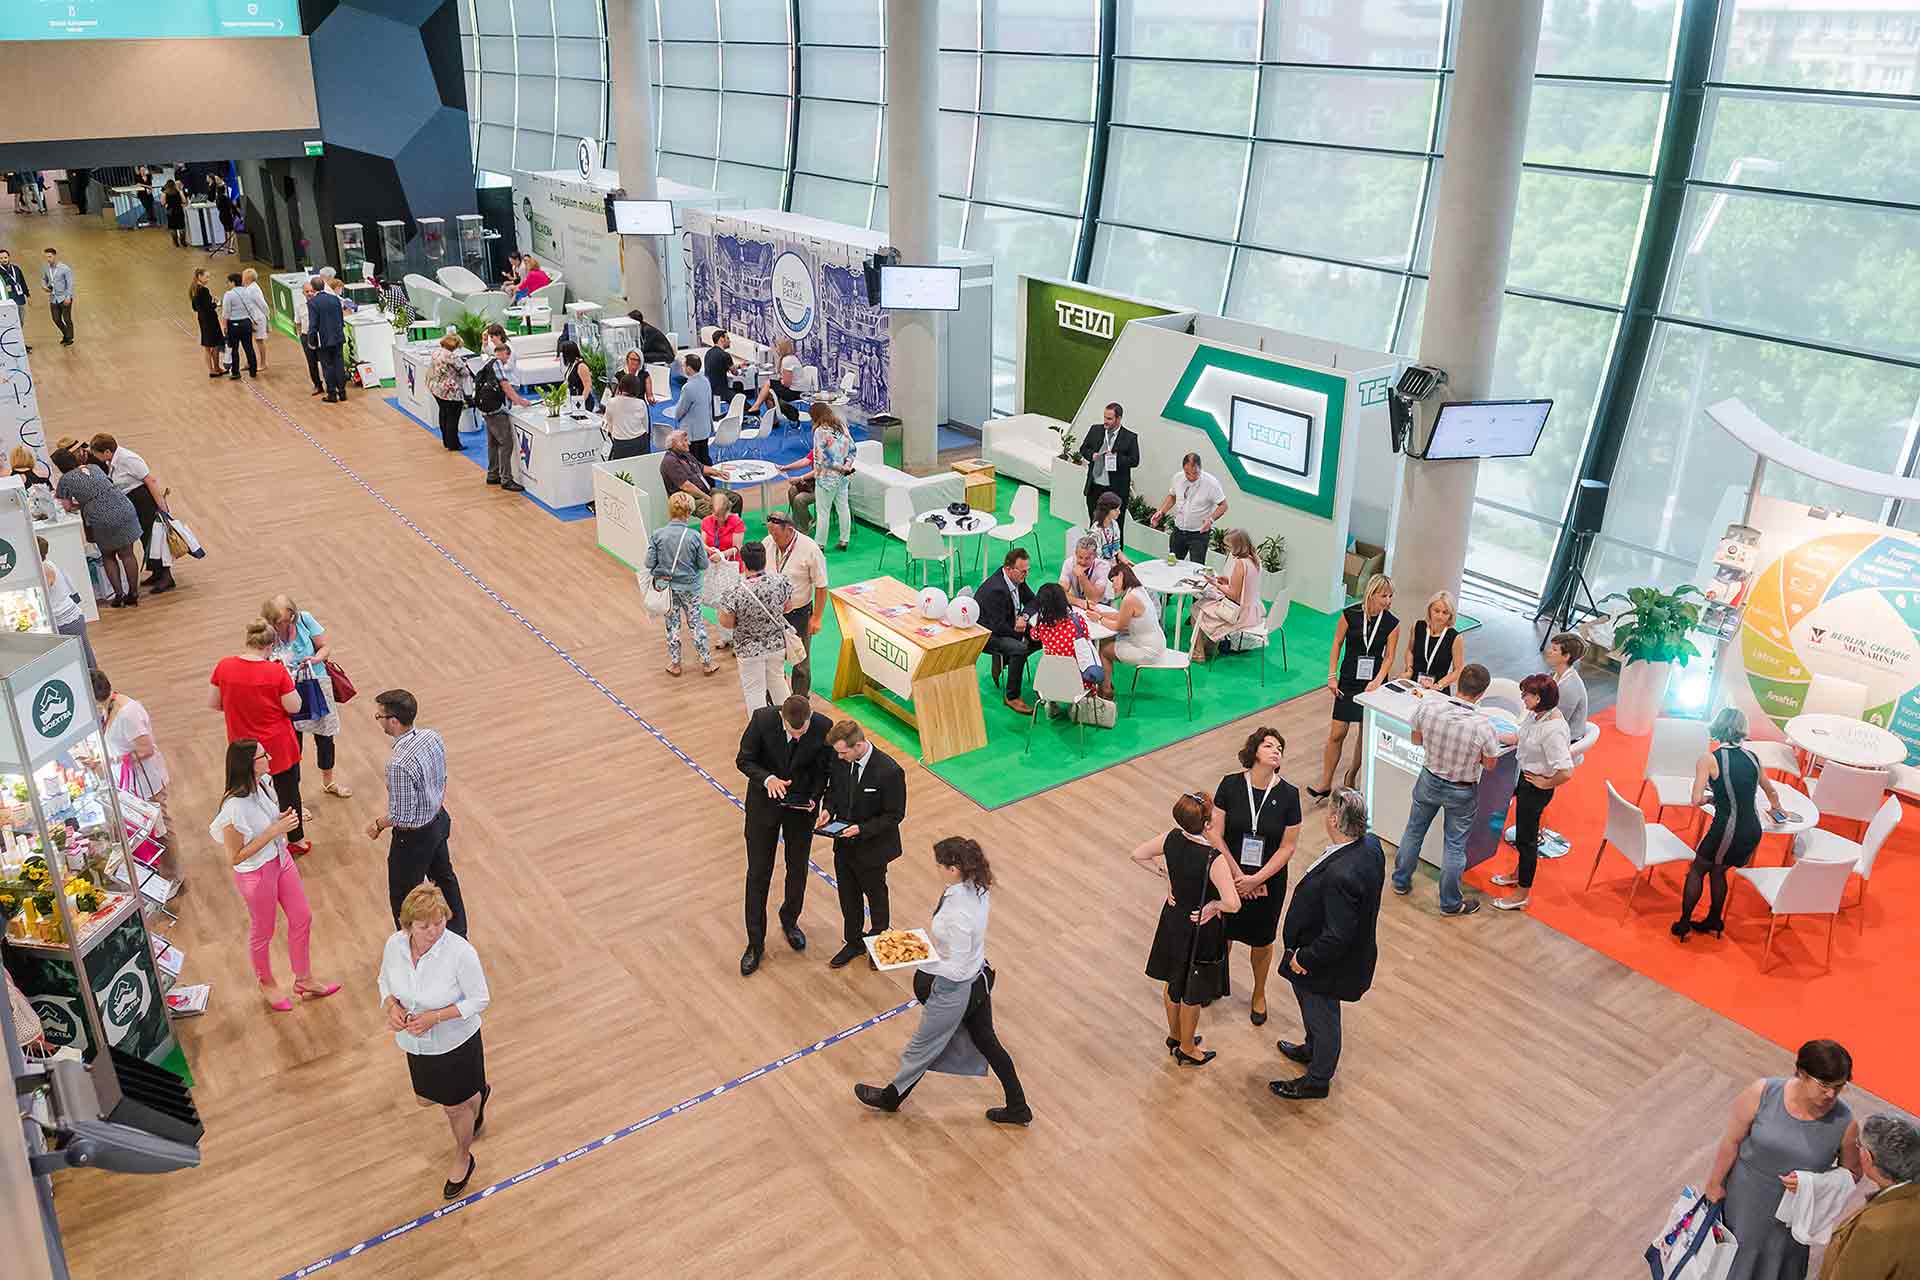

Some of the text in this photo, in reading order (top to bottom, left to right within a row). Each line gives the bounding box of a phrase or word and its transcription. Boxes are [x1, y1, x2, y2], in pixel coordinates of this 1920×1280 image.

[1055, 300, 1115, 340] TEVA
[1247, 421, 1292, 450] TEVA
[865, 627, 909, 672] TEVA
